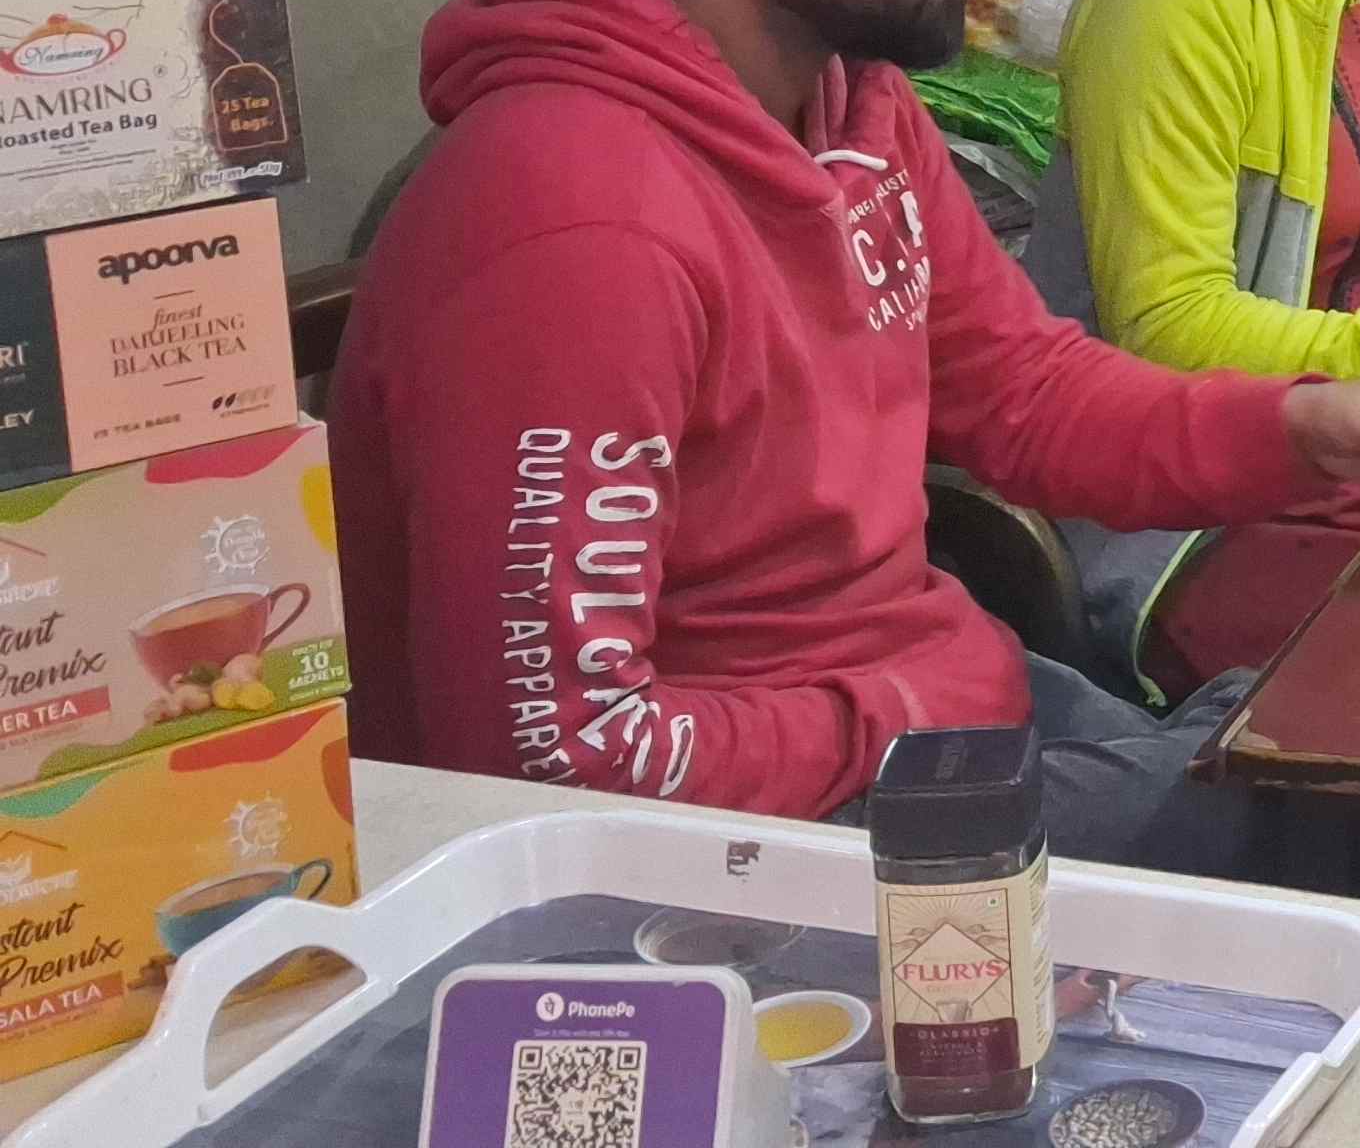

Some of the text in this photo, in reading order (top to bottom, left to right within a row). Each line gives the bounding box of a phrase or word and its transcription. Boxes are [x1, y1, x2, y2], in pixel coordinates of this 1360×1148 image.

[243, 96, 270, 110] Tea
[80, 118, 113, 135] Tea
[119, 112, 158, 130] Bag
[98, 234, 240, 284] apoorva
[152, 304, 203, 332] finest
[110, 313, 246, 354] DARJEELING
[113, 336, 247, 378] BLACK TEA
[114, 422, 141, 434] TEA
[500, 428, 571, 605] QUALITY
[300, 652, 329, 670] 10
[34, 700, 79, 726] TEA
[902, 959, 1004, 984] FLURYS
[61, 983, 103, 1010] TEA
[568, 1001, 635, 1018] PhonePe
